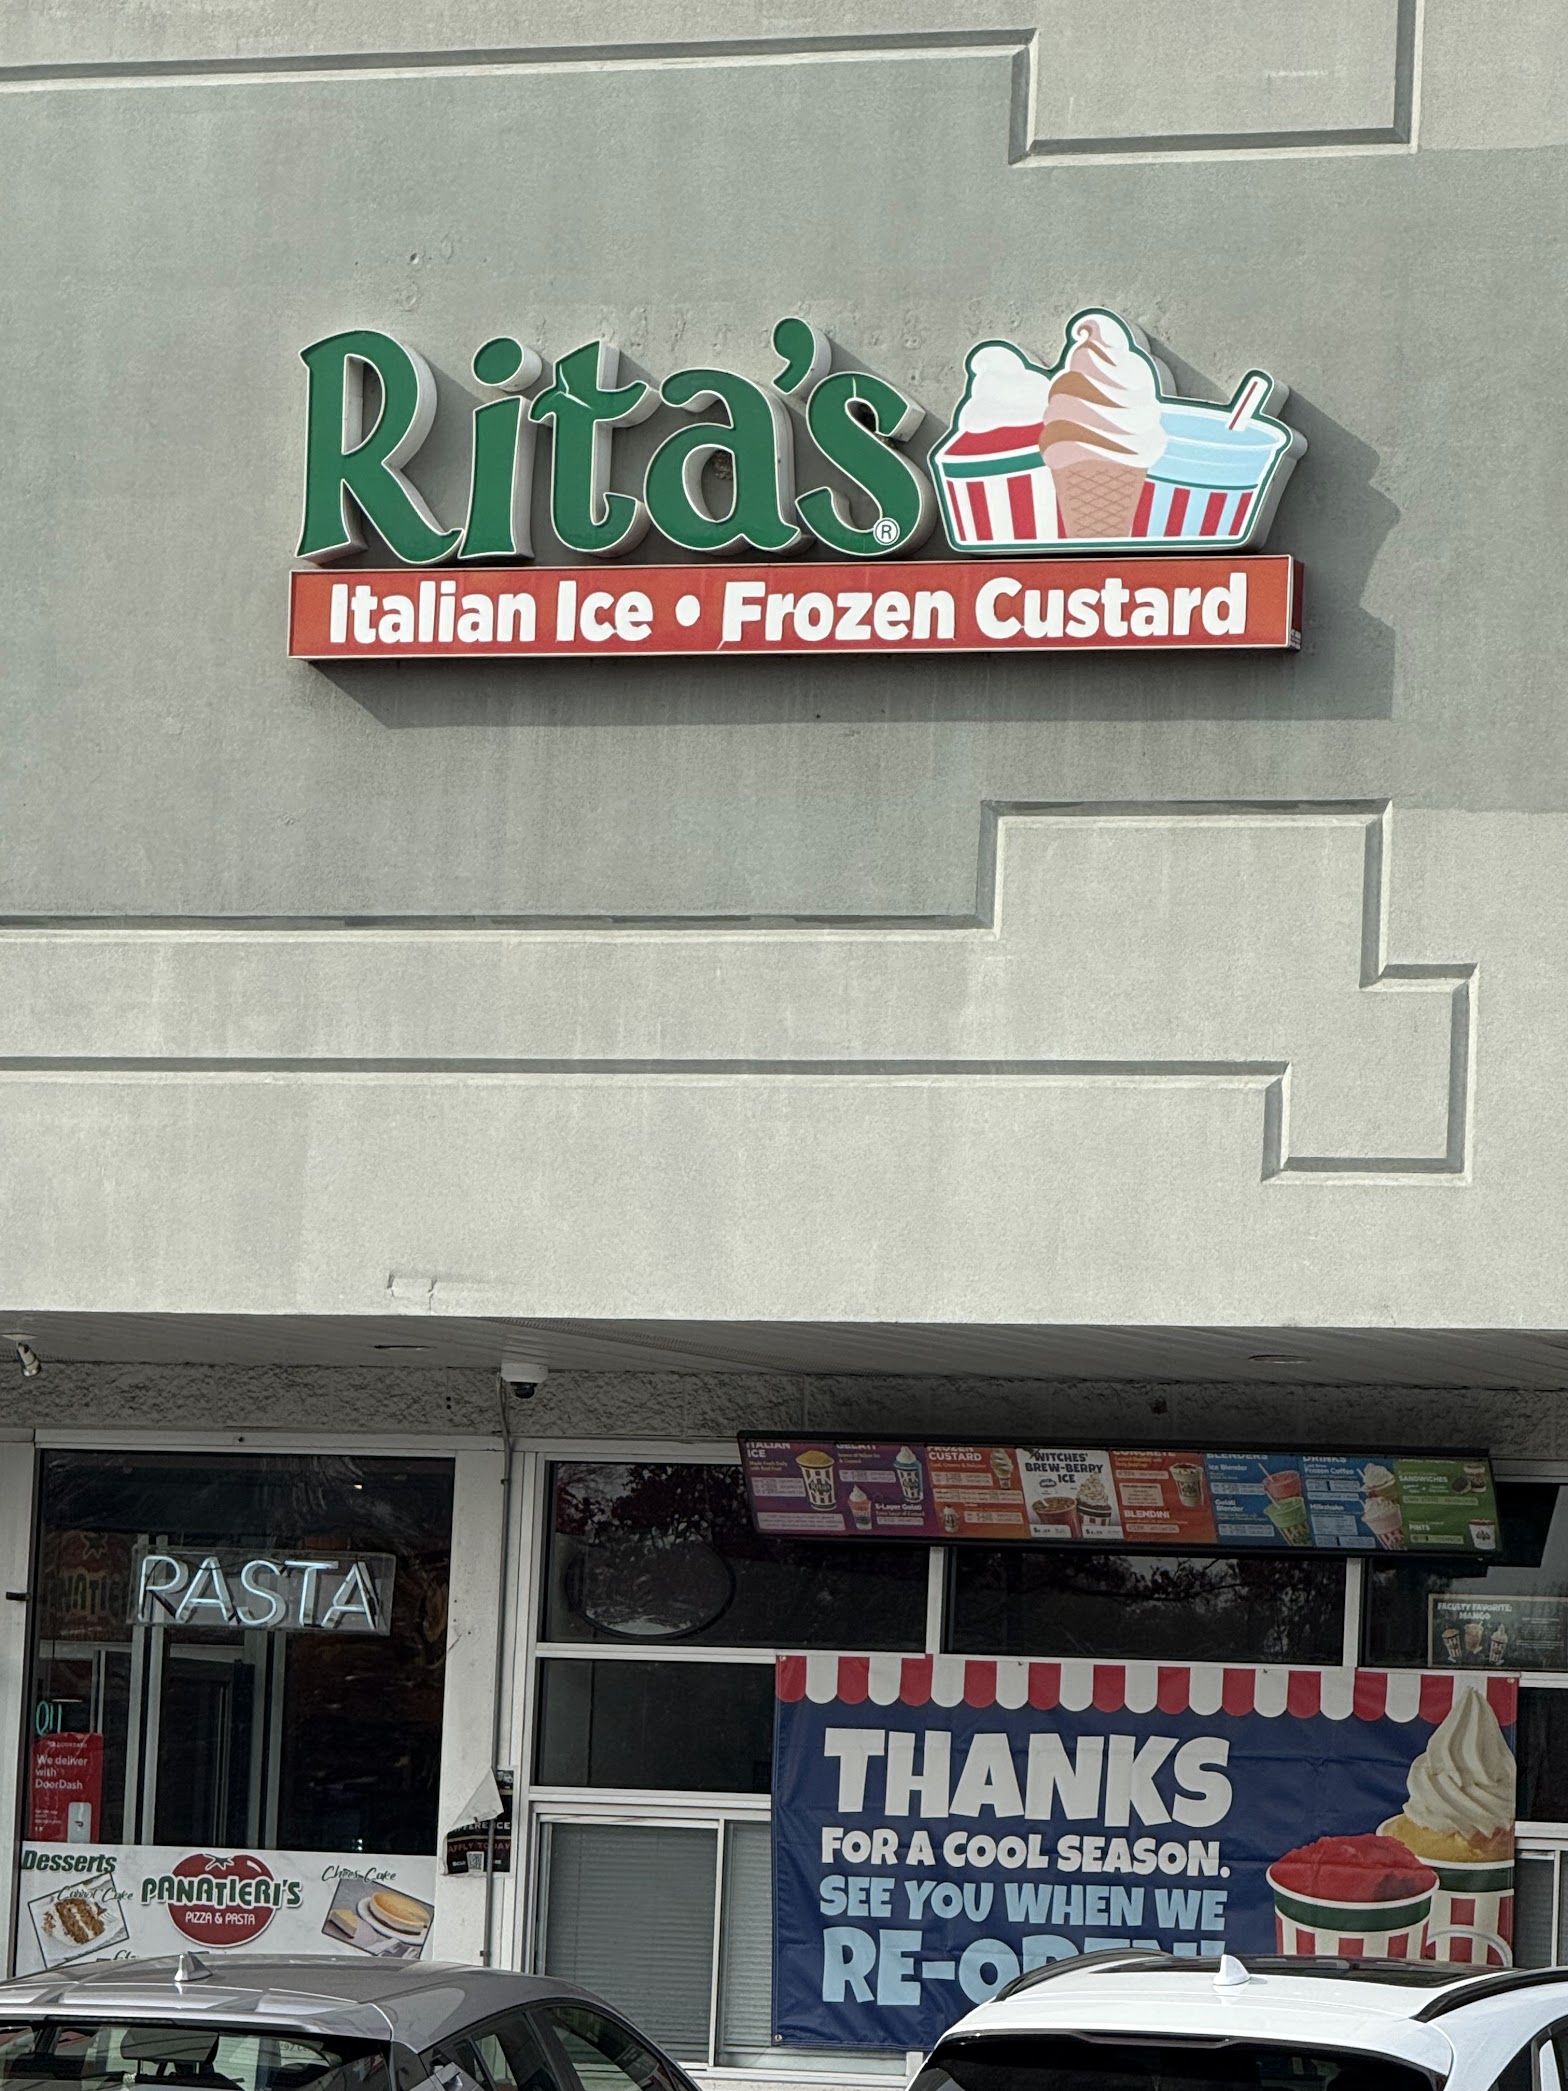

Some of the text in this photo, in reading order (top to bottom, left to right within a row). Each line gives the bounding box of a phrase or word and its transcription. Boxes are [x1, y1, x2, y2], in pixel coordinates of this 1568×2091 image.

[299, 318, 922, 562] Rita's
[330, 572, 1247, 643] Italian Ice Frozen Custard
[748, 1449, 767, 1458] ICE
[928, 1452, 982, 1462] CUSTARD
[1034, 1453, 1089, 1463] WITCHES'
[1025, 1463, 1104, 1474] BREW-BERRY
[1058, 1473, 1076, 1483] ICE
[1124, 1510, 1171, 1519] BLENDINI
[138, 1554, 379, 1630] PASTA
[36, 1754, 88, 1767] We deliver
[35, 1767, 57, 1778] with
[823, 1727, 1233, 1828] THANKS
[35, 1778, 83, 1790] DoorDash
[821, 1827, 1230, 1879] FOR A COOL SEASON.
[22, 1850, 117, 1873] Desserts
[363, 1867, 397, 1884] Cake
[102, 1887, 134, 1903] Cake
[140, 1875, 302, 1907] PANATIERI'S
[820, 1875, 1228, 1931] SEE YOU WHEN WE
[185, 1911, 256, 1926] PIZZA & PASTA
